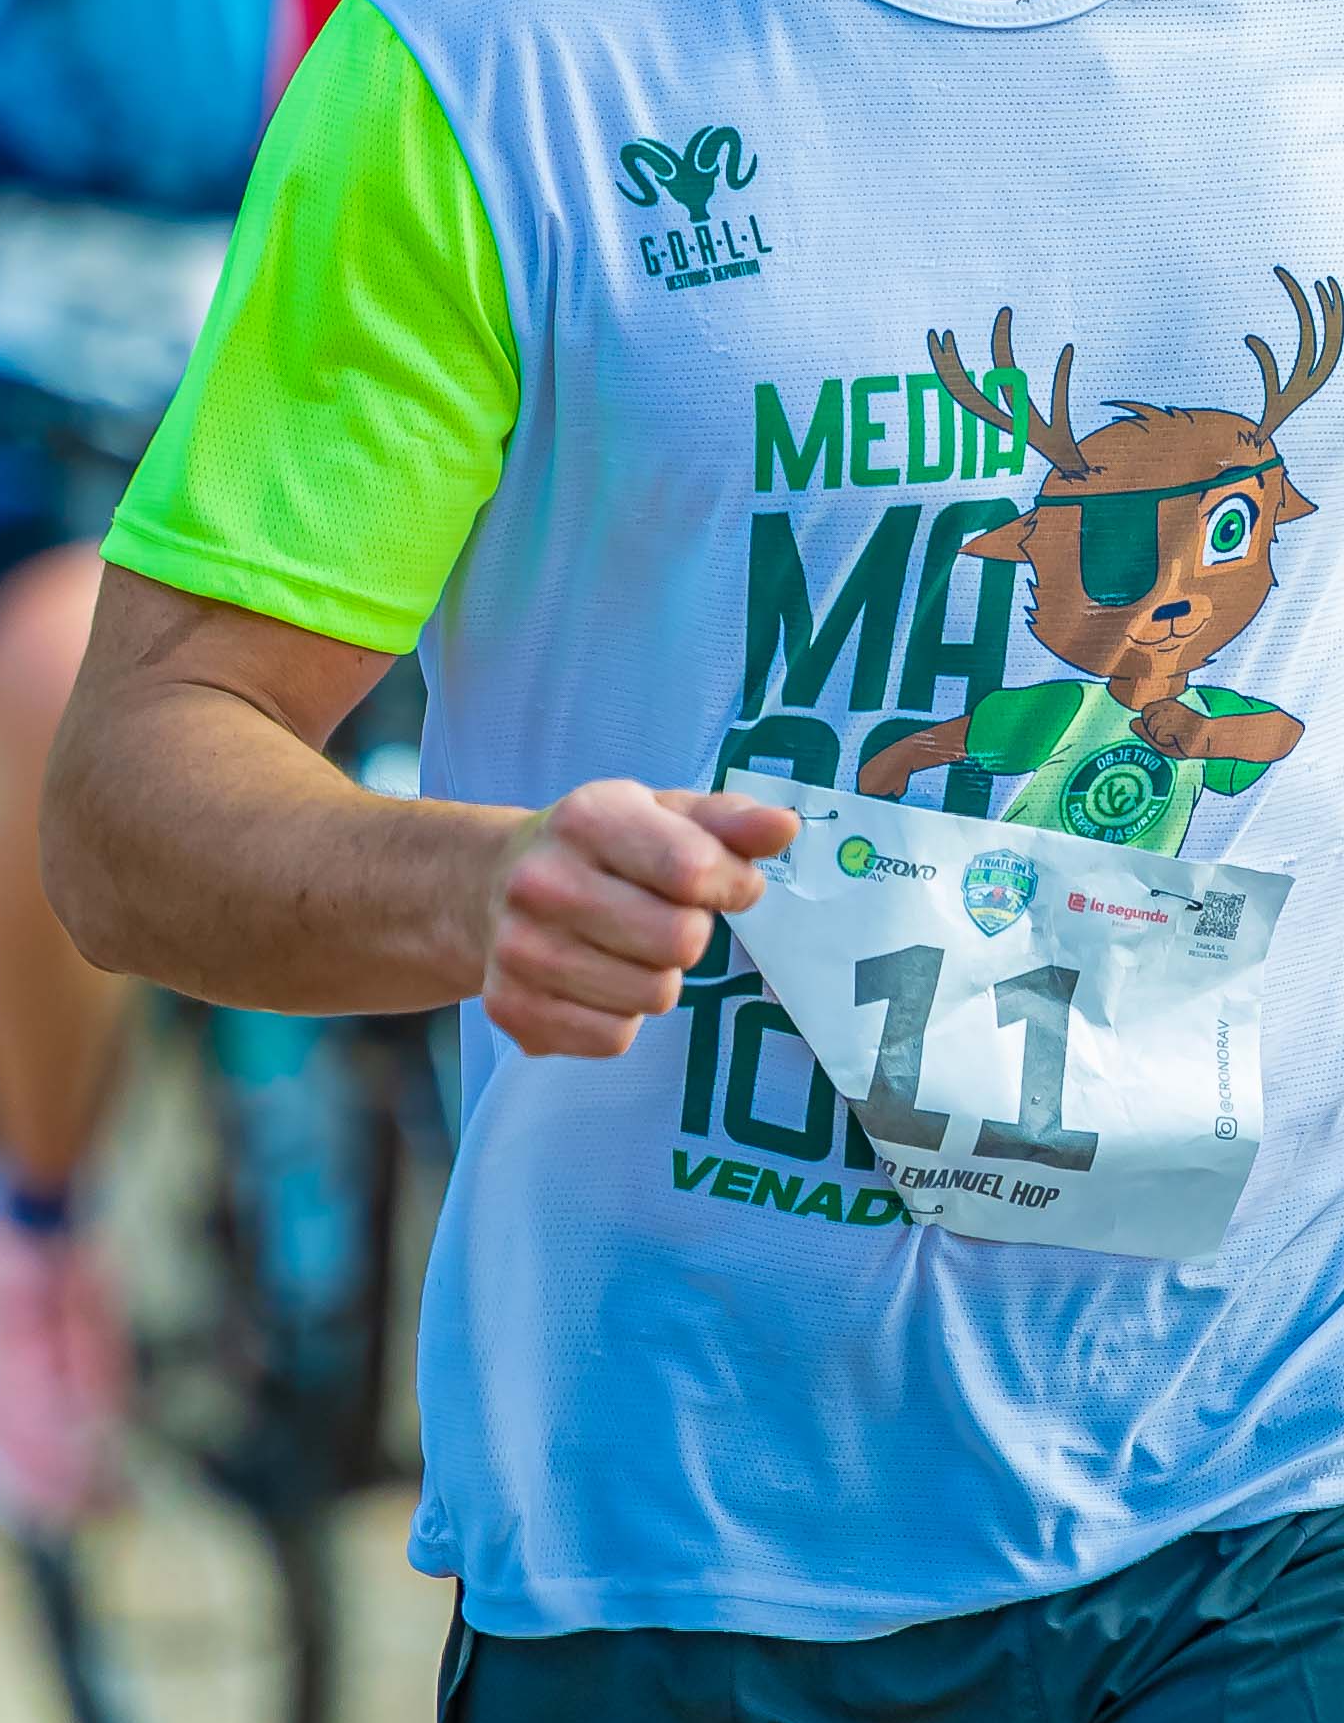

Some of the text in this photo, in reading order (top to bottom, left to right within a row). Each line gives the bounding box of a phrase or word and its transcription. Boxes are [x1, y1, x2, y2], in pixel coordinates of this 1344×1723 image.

[754, 366, 1029, 494] MEDIA
[735, 497, 1020, 722] MA
[1096, 748, 1162, 772] OBJETIVO
[1103, 803, 1162, 843] BASURAL
[863, 853, 937, 881] CRONO
[1090, 897, 1169, 924] la segunda
[678, 971, 877, 1171] TO
[846, 944, 1099, 1172] 11
[1217, 1019, 1234, 1113] @CRONORAV
[672, 1148, 914, 1227] VENAD
[899, 1166, 1004, 1200] EMANUEL
[1009, 1179, 1060, 1209] HOP
